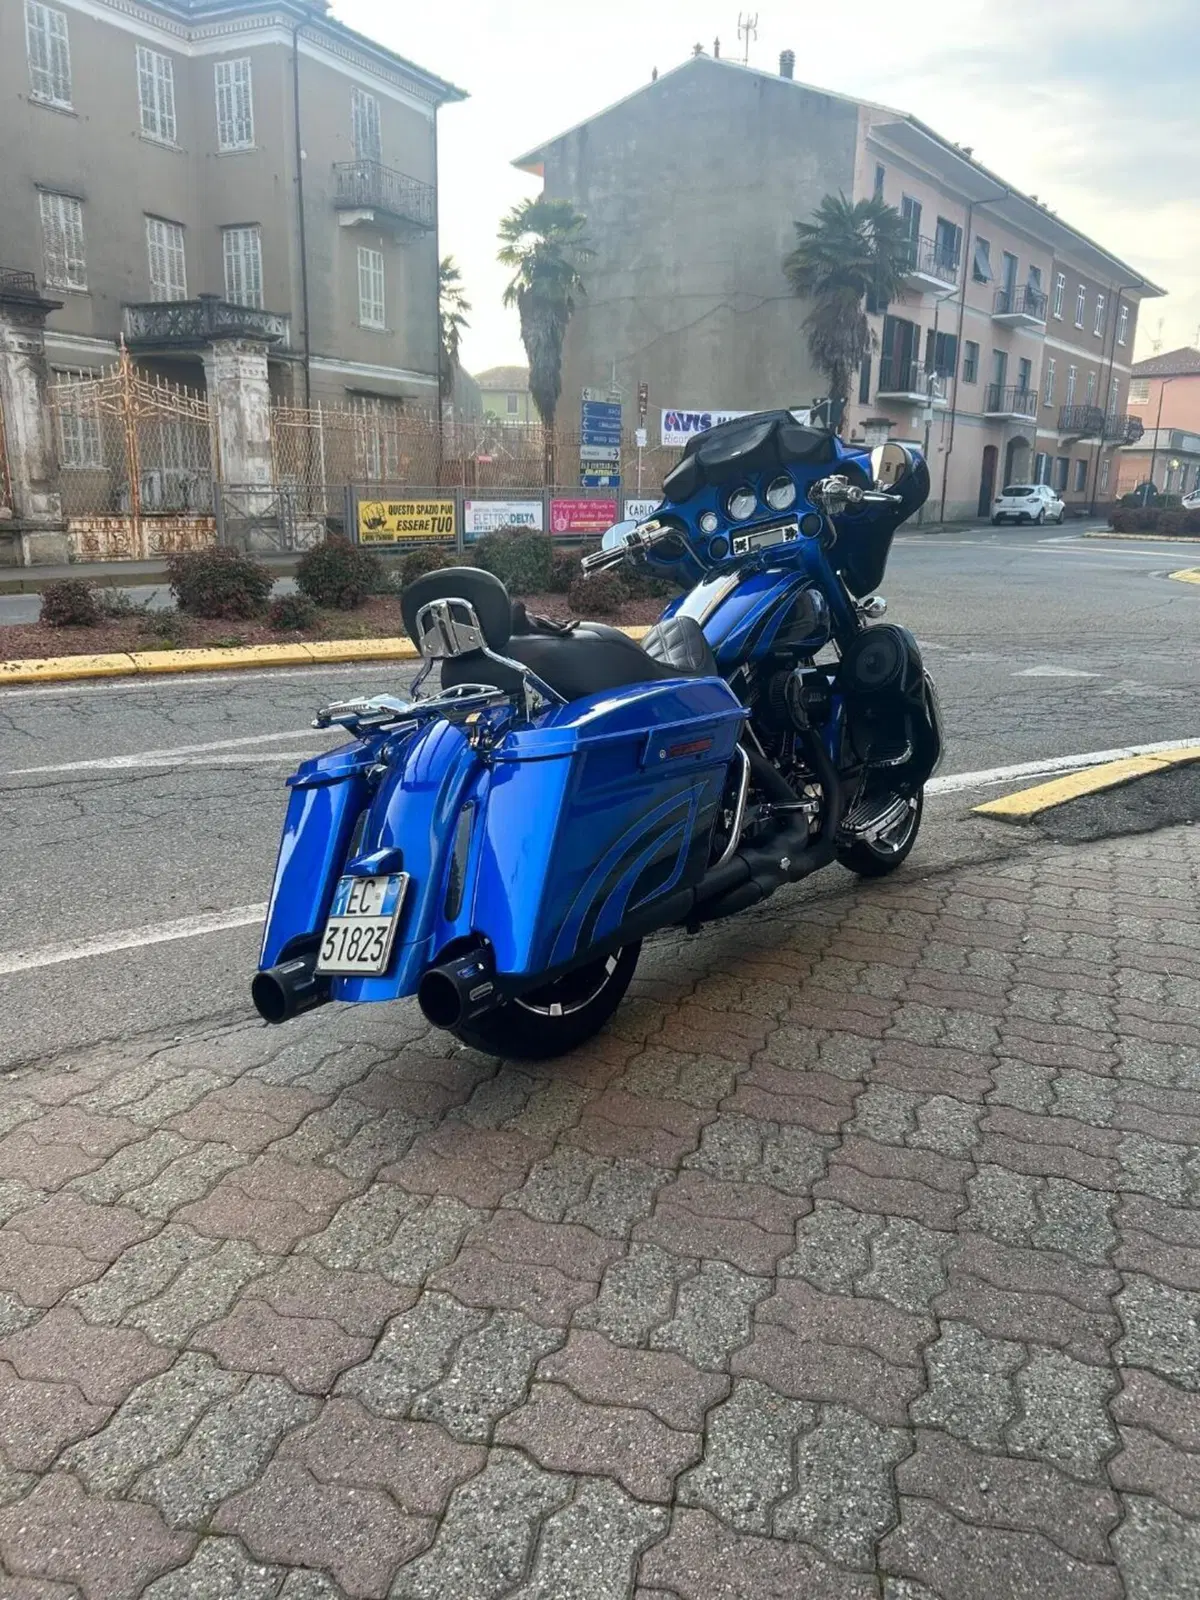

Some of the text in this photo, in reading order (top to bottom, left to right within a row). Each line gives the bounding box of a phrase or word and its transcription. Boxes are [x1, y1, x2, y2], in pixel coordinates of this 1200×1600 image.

[664, 412, 712, 432] AVIS
[664, 434, 688, 445] Ricor
[388, 504, 415, 516] QUESTO
[416, 504, 439, 515] SPAZIO
[629, 504, 654, 516] CARLO
[396, 516, 453, 533] ESSERE TUO
[346, 879, 376, 914] EC
[322, 926, 388, 962] 31823
